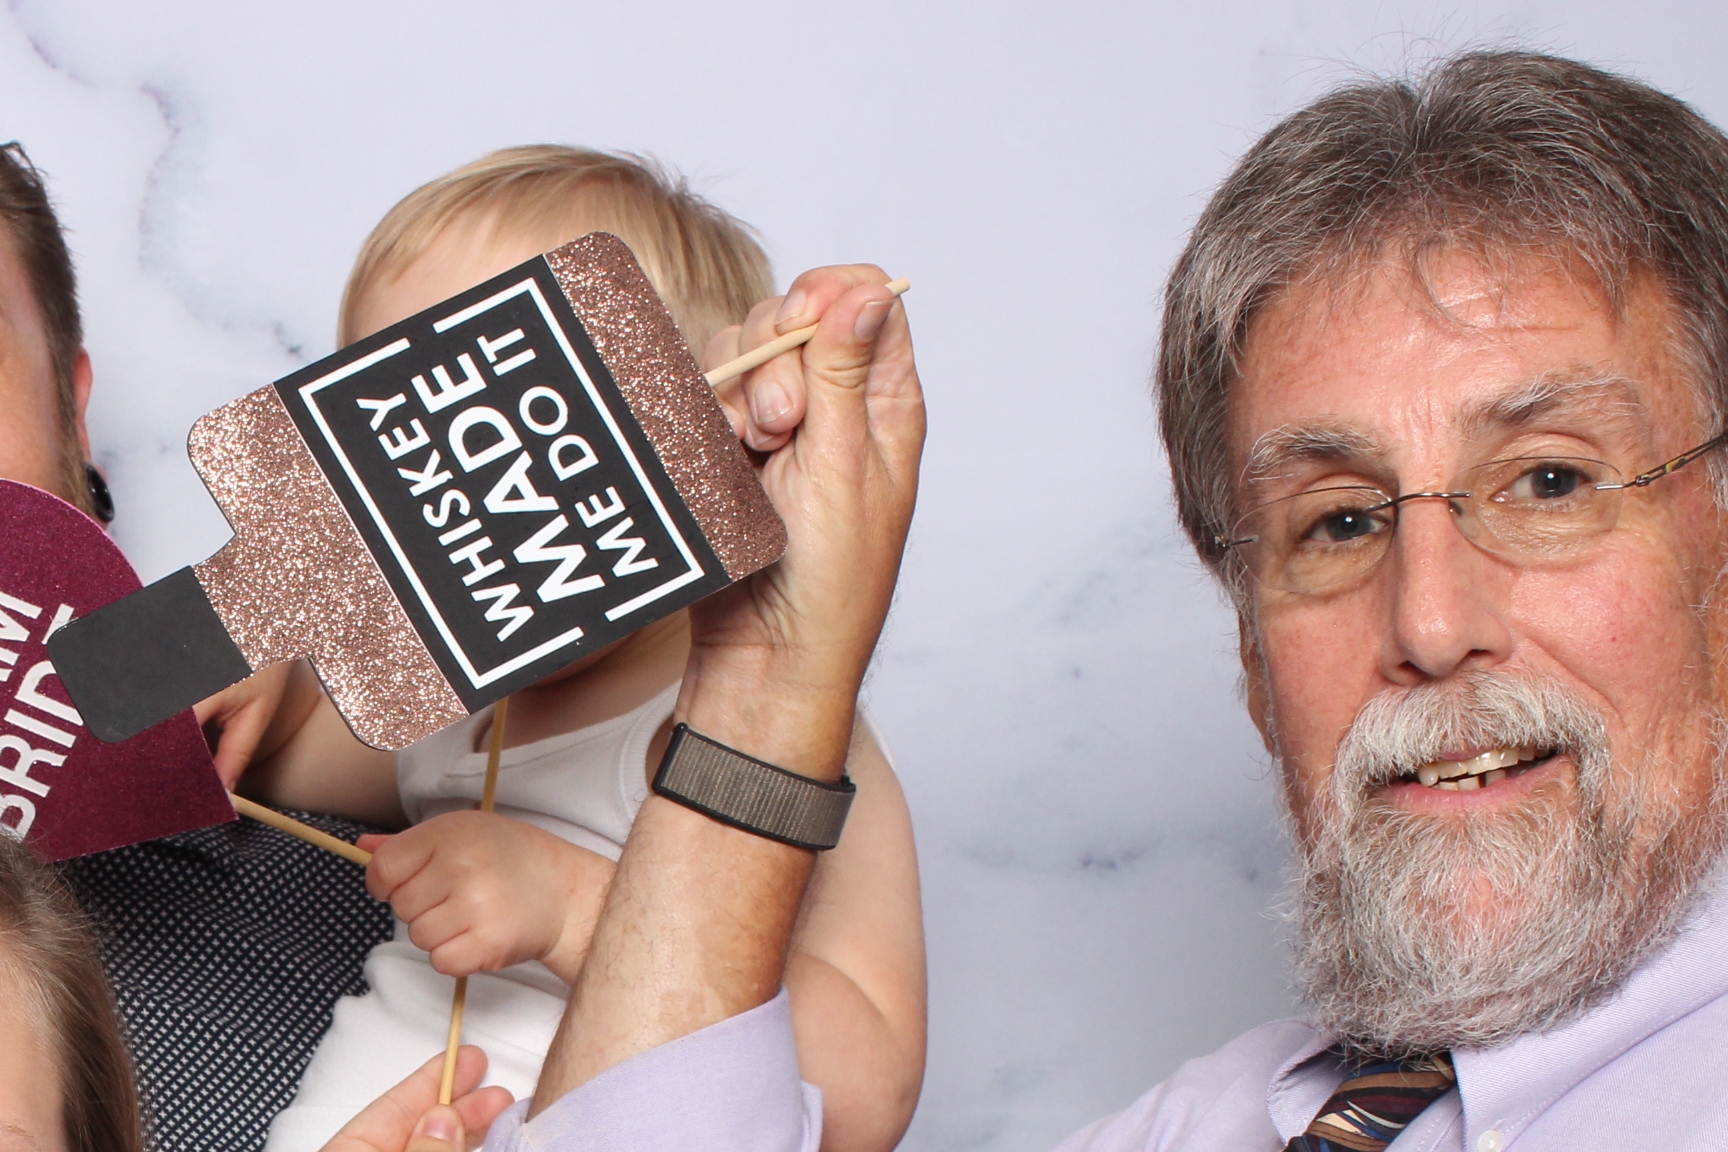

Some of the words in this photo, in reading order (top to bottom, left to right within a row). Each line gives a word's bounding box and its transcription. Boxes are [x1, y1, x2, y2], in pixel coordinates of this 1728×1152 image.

[477, 328, 536, 377] IT
[411, 352, 605, 602] MADE
[519, 386, 599, 481] DO
[356, 392, 534, 642] WHISKEY
[575, 487, 658, 577] ME
